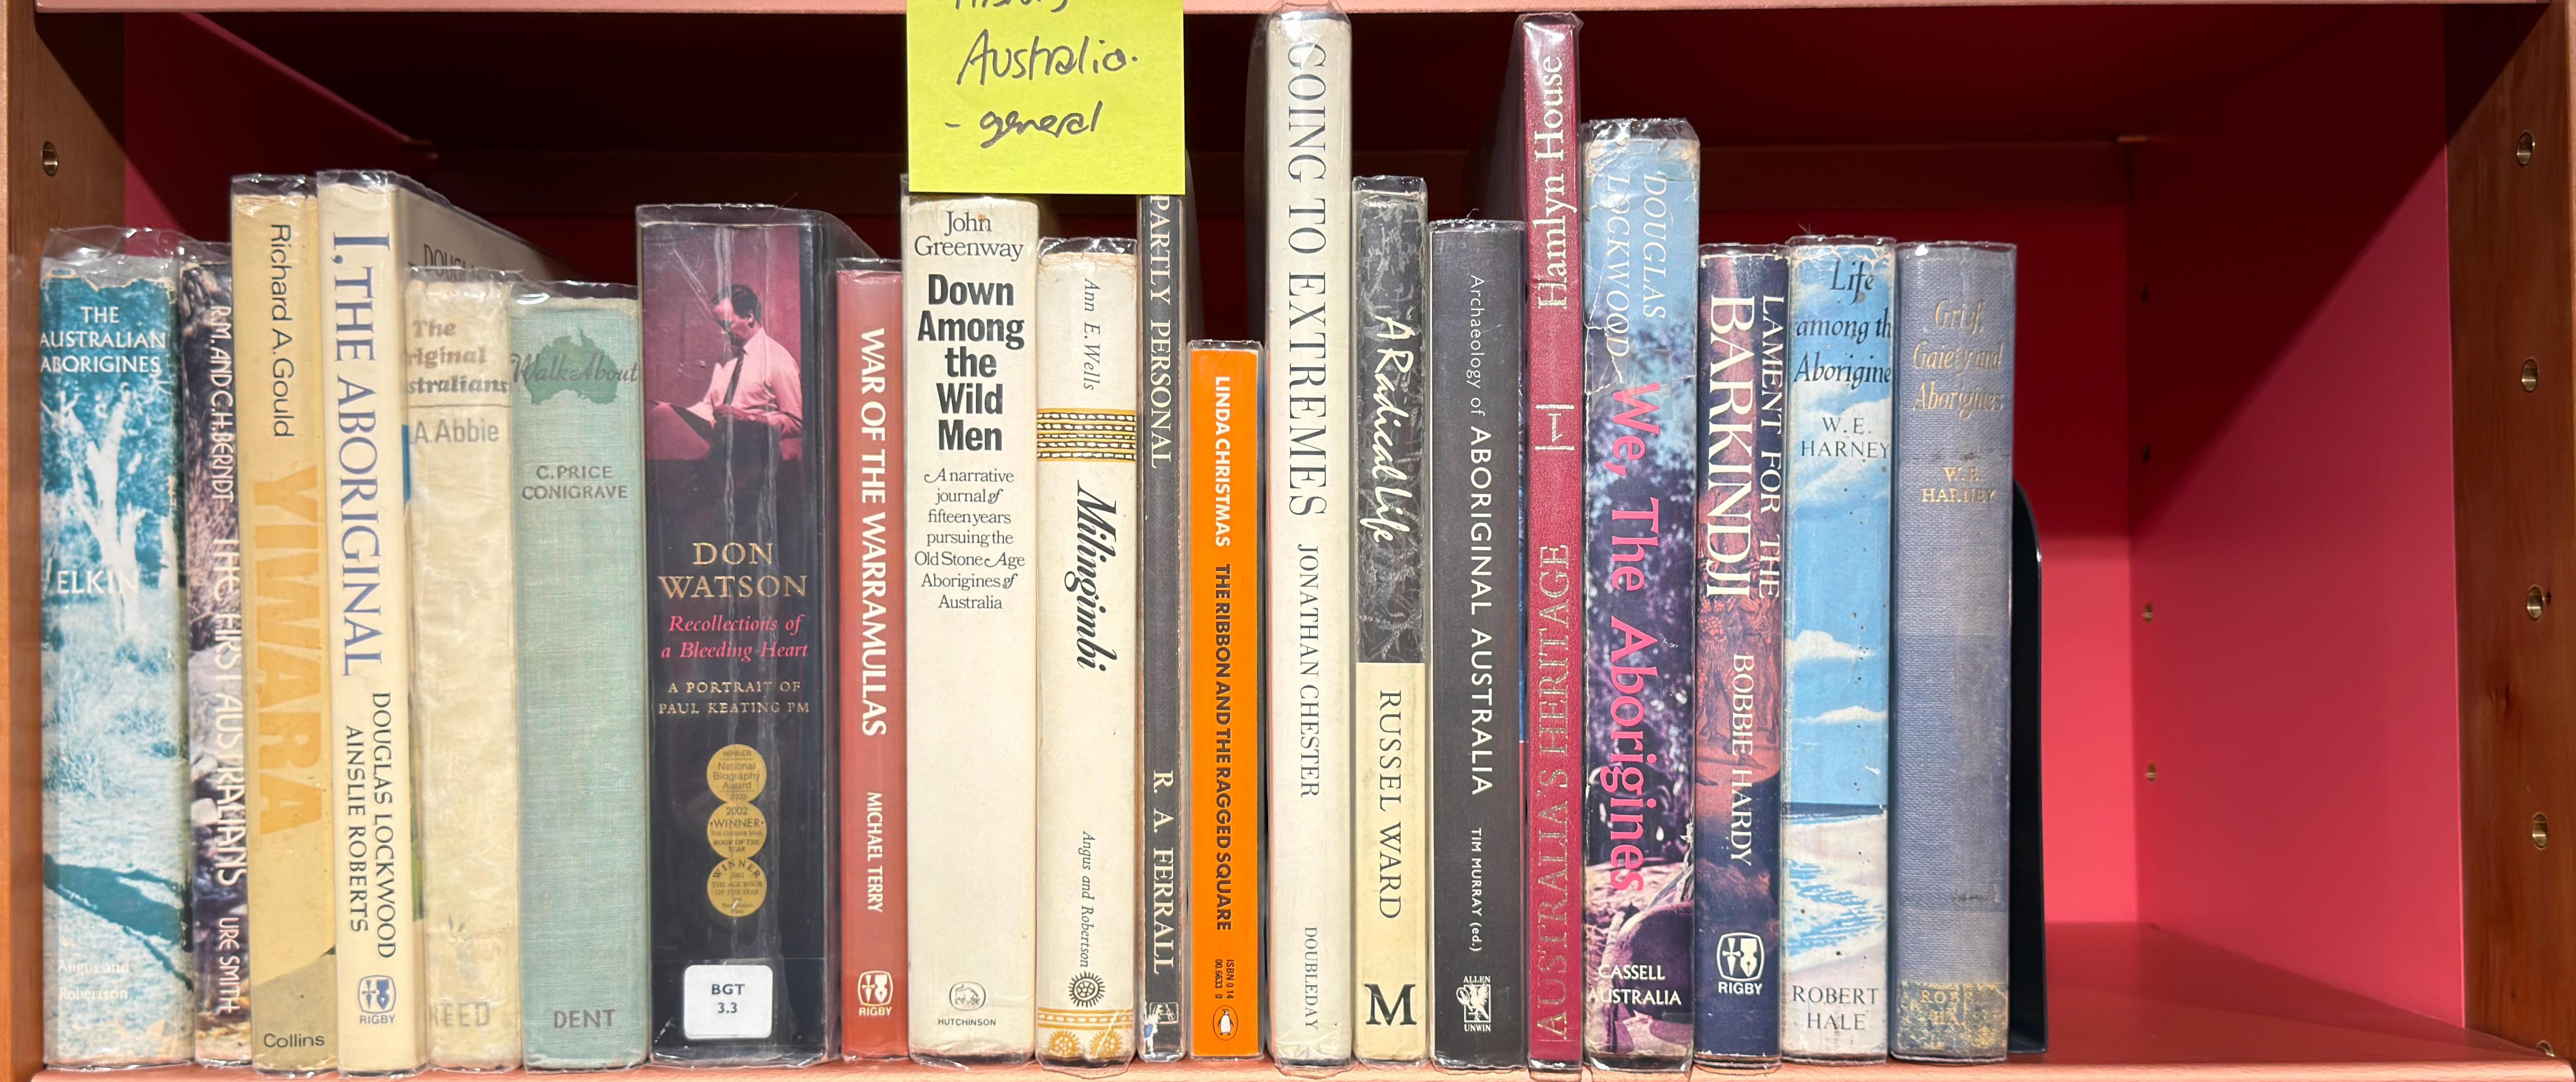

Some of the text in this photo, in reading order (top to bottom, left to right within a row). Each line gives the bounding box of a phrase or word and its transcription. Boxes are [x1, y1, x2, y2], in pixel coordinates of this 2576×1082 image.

[980, 100, 1103, 149] general
[1532, 55, 1577, 310] Hamlyn House
[944, 210, 992, 236] John
[914, 235, 1025, 262] Greenway
[1643, 173, 1667, 319] DOUGLAS
[271, 224, 293, 321] Richard
[1288, 42, 1327, 515] GOING TO EXTREMES
[1606, 175, 1630, 357] LOCKWOOD
[928, 274, 1014, 306] Down
[1084, 278, 1101, 312] Ann
[1829, 260, 1875, 305] Life
[80, 306, 119, 324] THE
[40, 332, 166, 349] AUSTRALIAN
[412, 320, 456, 337] The
[917, 310, 1025, 350] Among
[1150, 195, 1172, 469] PARTLY PERSONAL
[1797, 319, 1870, 344] among
[40, 355, 161, 373] ABORIGINES
[944, 346, 997, 378] the
[1913, 340, 2004, 377] Gaiety and
[936, 383, 1003, 414] Wild
[1912, 381, 2003, 419] Aborigines
[435, 419, 499, 443] Abbie
[938, 419, 1002, 451] Men
[1360, 315, 1415, 543] A Radical Life
[1705, 294, 1755, 597] BARKINDJI
[1759, 295, 1784, 599] LAMENT FOR THE
[1802, 441, 1889, 459] HARNEY
[1216, 376, 1231, 547] LINDA CHRISTMAS
[924, 467, 1014, 483] A narrative
[522, 485, 628, 499] CONIGRAVE
[935, 488, 1004, 505] journal of
[1921, 488, 1996, 503] HARNEY
[337, 374, 384, 677] ABORIGINAL
[928, 509, 1011, 526] fifteen years
[861, 328, 887, 736] WAR OF THE WARRAMULLAS
[927, 529, 1014, 547] pursuing the
[1466, 275, 1493, 796] Archaeology of ABORIGINAL AUSTRALIA
[693, 543, 774, 565] DON
[915, 551, 1026, 570] Old Stone Age
[58, 570, 139, 593] ELKIN
[658, 575, 808, 599] WATSON
[921, 573, 1018, 591] Aborigines of
[1064, 479, 1118, 672] Milingimbi
[938, 594, 1003, 609] Australia
[669, 614, 805, 636] Recollections of
[1600, 382, 1660, 891] We, The Aborigines
[253, 465, 323, 835] YIWARA
[661, 642, 808, 662] a Bleeding Heart
[1538, 544, 1570, 756] HERITAGE
[1298, 543, 1320, 798] JONATHAN CHESTER
[668, 681, 800, 693] A PORTRAIT OF
[659, 702, 809, 714] PAUL KEATING PM
[1216, 564, 1232, 930] THE RIBBON AND THE RAGGED SQUARE
[718, 762, 756, 770] National
[1730, 654, 1755, 867] BOBBIE HARDY
[713, 772, 760, 782] Biography
[726, 807, 749, 815] 2002
[1379, 690, 1401, 919] RUSSEL WARD
[346, 725, 369, 932] AINSLIE ROBERTS
[373, 691, 397, 958] DOUGLAS LOCKWOOD
[867, 792, 883, 913] MICHAEL TERRY
[712, 859, 761, 879] WINNER
[1154, 770, 1175, 975] R. A. FERRALL
[1078, 830, 1096, 968] Angus and Robertson
[1469, 827, 1482, 952] TIM MURRAY (ed.)
[58, 961, 130, 974] Angus and
[219, 917, 241, 1013] URE SMITH
[1226, 959, 1234, 981] ISBN
[1598, 965, 1665, 981] CASSELL
[712, 984, 745, 995] BGT
[1304, 927, 1318, 1030] DOUBLEDAY
[1718, 981, 1763, 995] RIGBY
[59, 988, 129, 1000] Robertson
[1364, 983, 1417, 1026] M
[1587, 988, 1682, 1006] AUSTRALIA
[1792, 985, 1878, 1004] ROBERT
[359, 1014, 395, 1024] RIGBY
[554, 1009, 616, 1028] DENT
[718, 1002, 738, 1013] 3.3
[859, 1007, 892, 1016] RIGBY
[938, 1018, 996, 1026] HUTCHINSON
[1464, 1024, 1491, 1032] UNWIN
[1807, 1012, 1866, 1029] HALE
[264, 1033, 325, 1048] Collins
